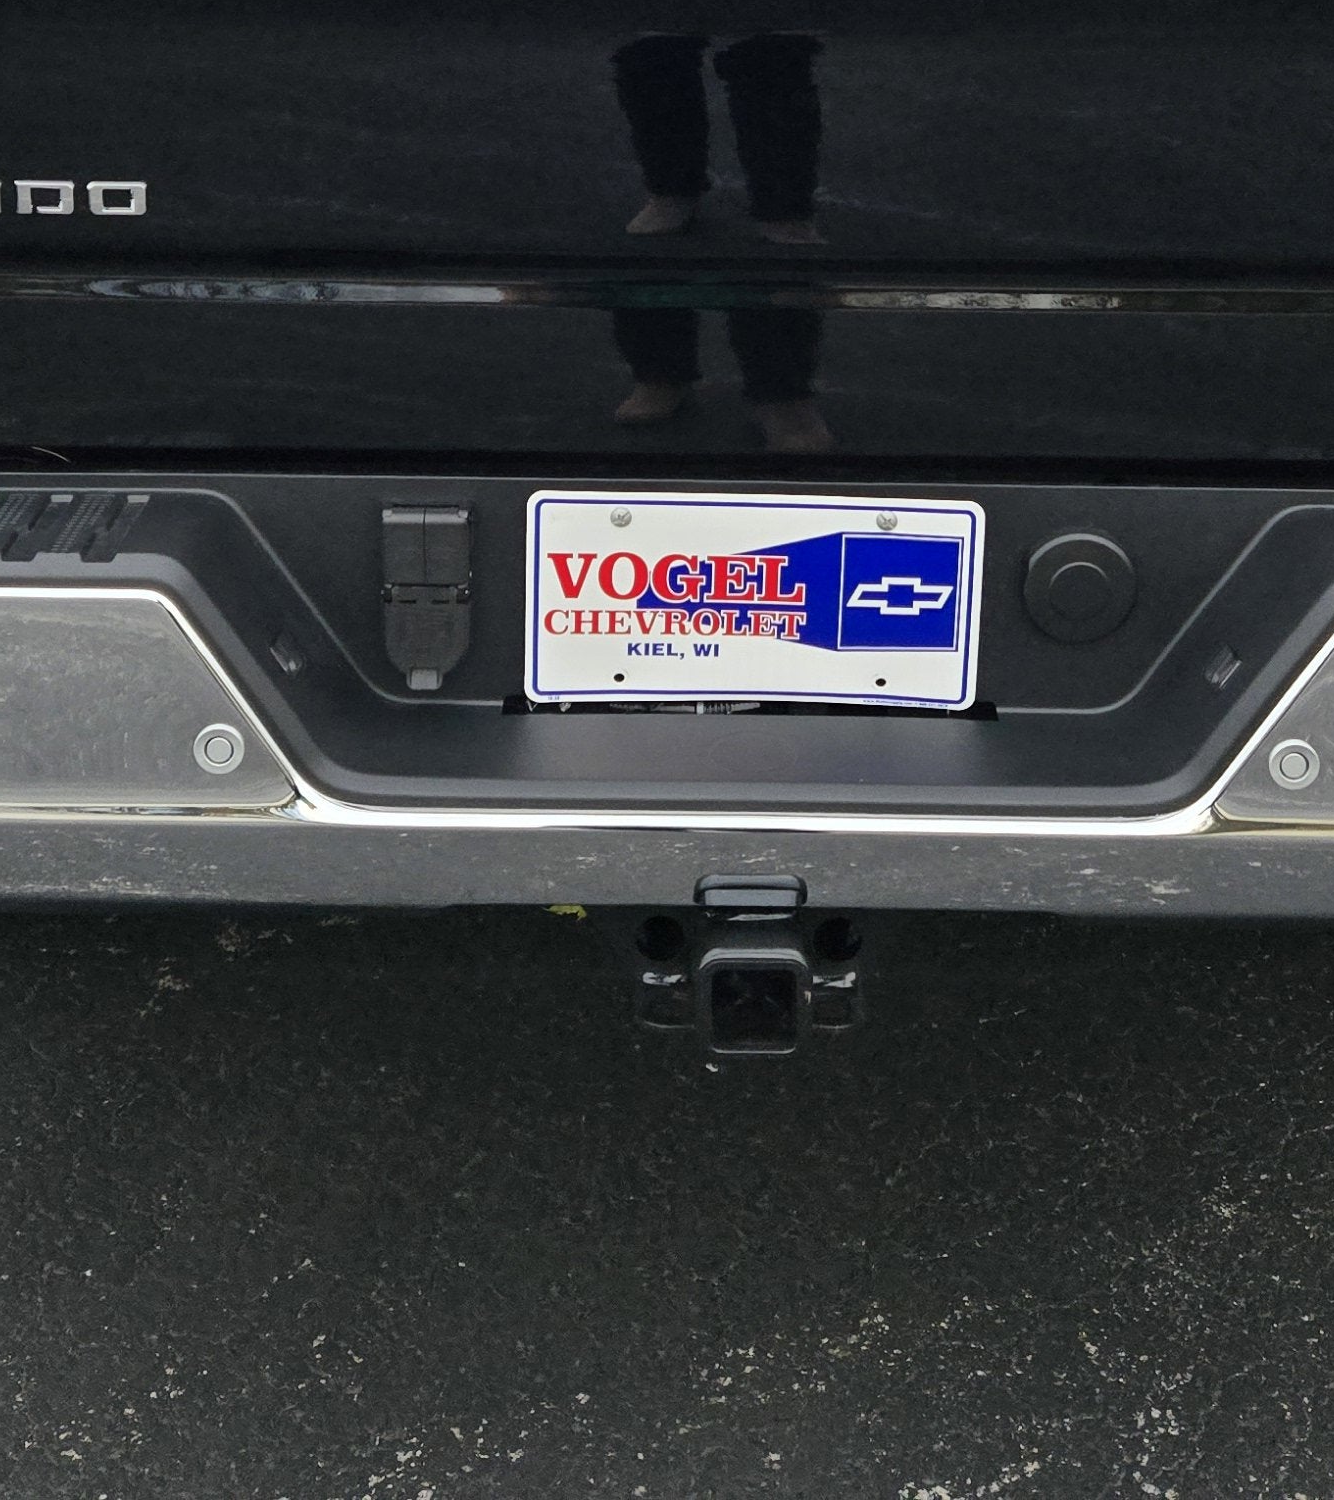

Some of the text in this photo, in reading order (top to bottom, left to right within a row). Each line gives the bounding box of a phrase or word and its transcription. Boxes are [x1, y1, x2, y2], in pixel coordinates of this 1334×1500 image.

[547, 551, 806, 606] VOGEL
[543, 608, 807, 640] CHEVROLET
[627, 642, 720, 660] KIEL, WI
